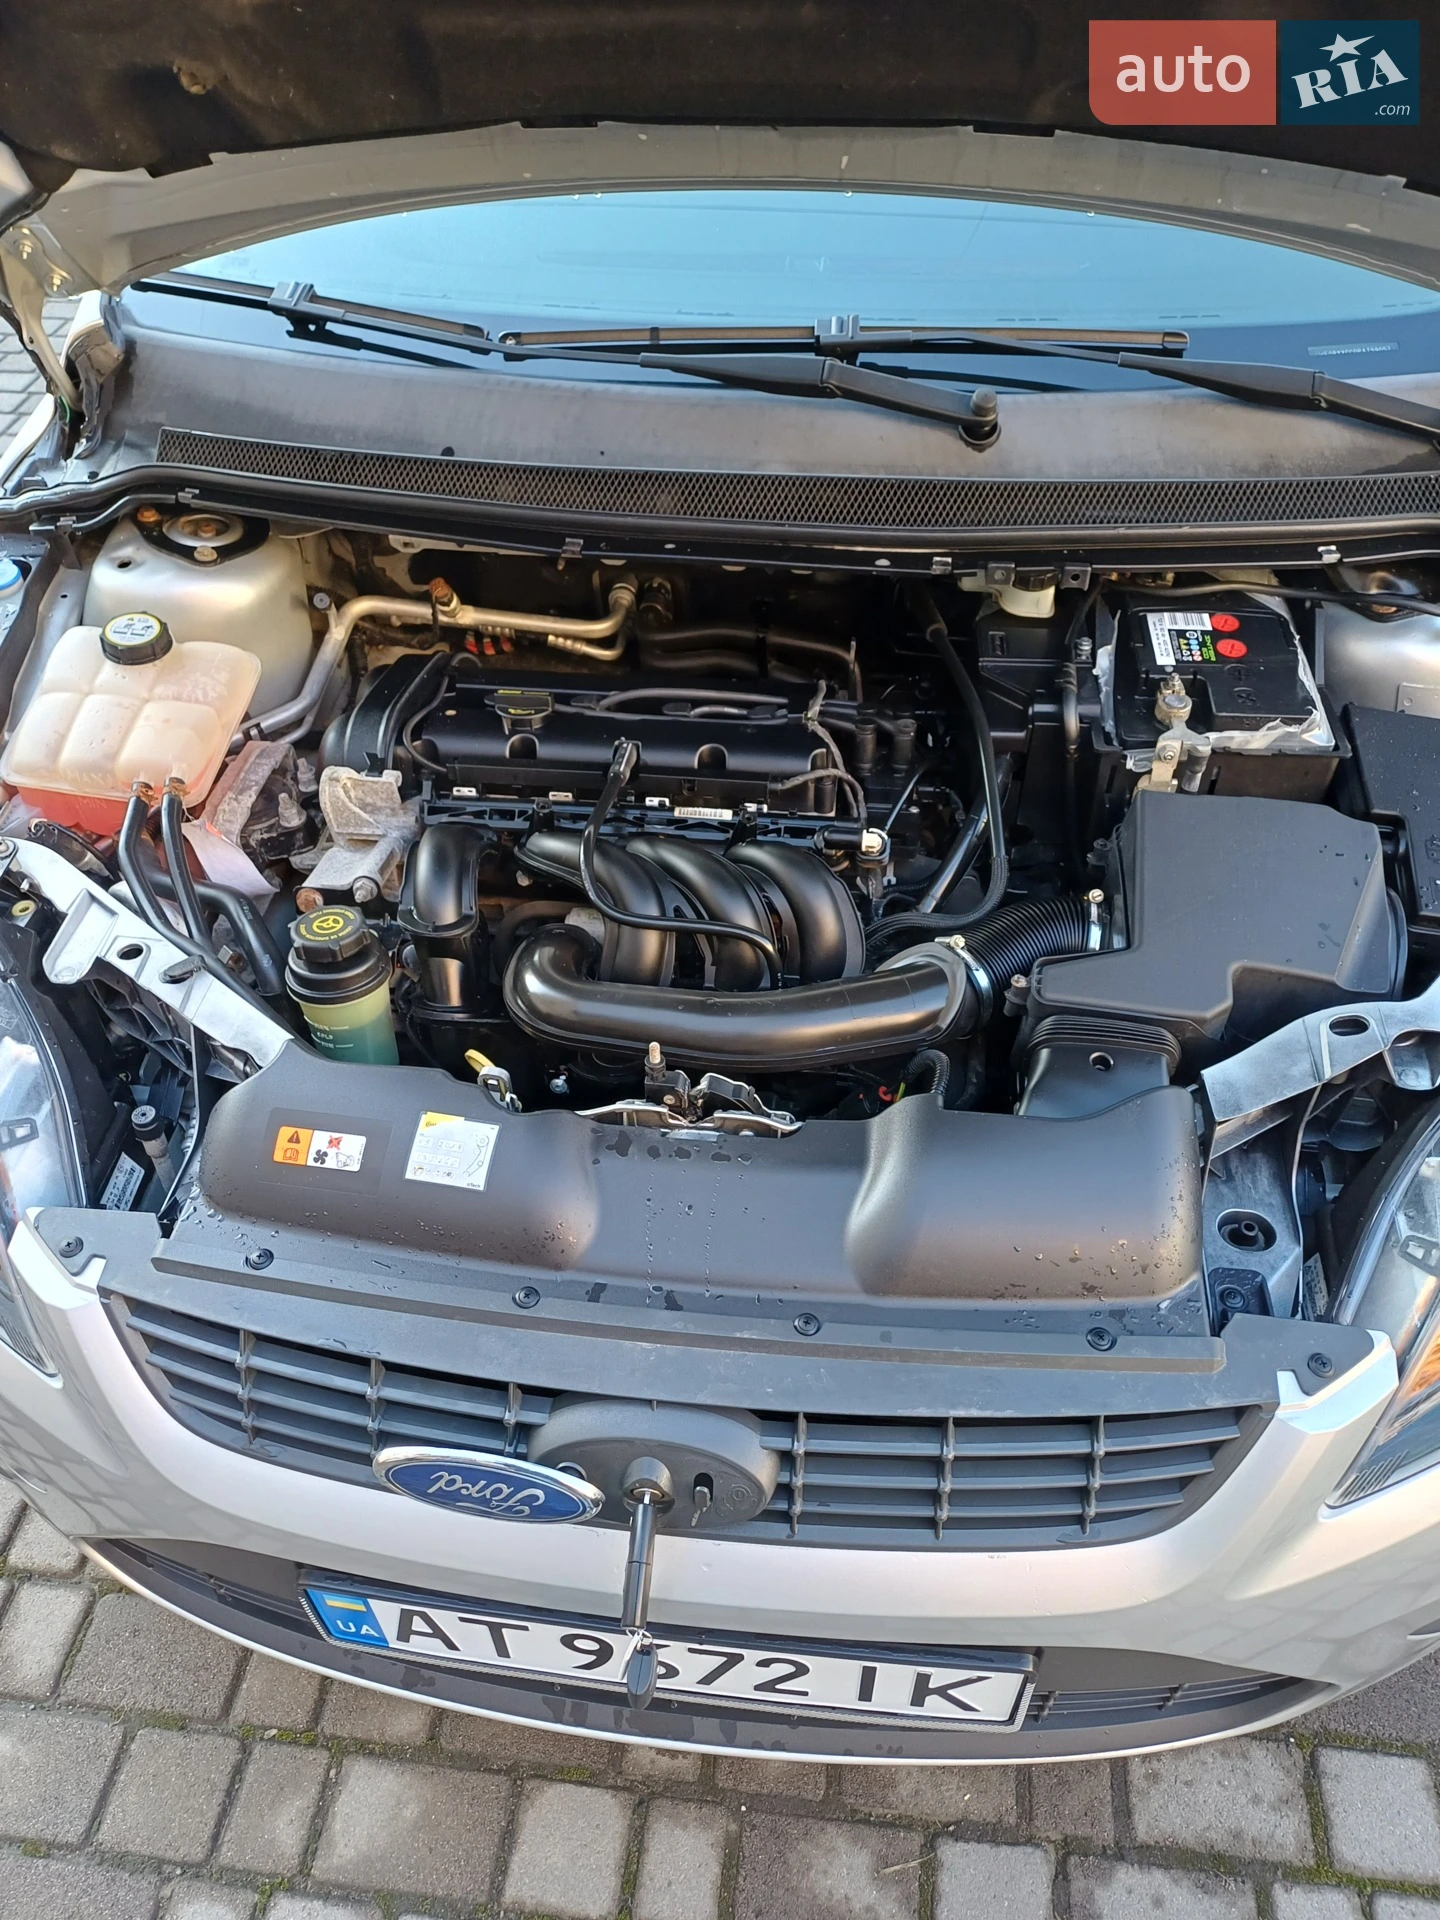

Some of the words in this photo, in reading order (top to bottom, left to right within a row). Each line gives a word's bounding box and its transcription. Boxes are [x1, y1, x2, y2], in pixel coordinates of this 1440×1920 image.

[427, 1471, 546, 1517] Ford
[336, 1618, 378, 1638] UA
[399, 1609, 530, 1660] AT
[857, 1665, 995, 1713] IK
